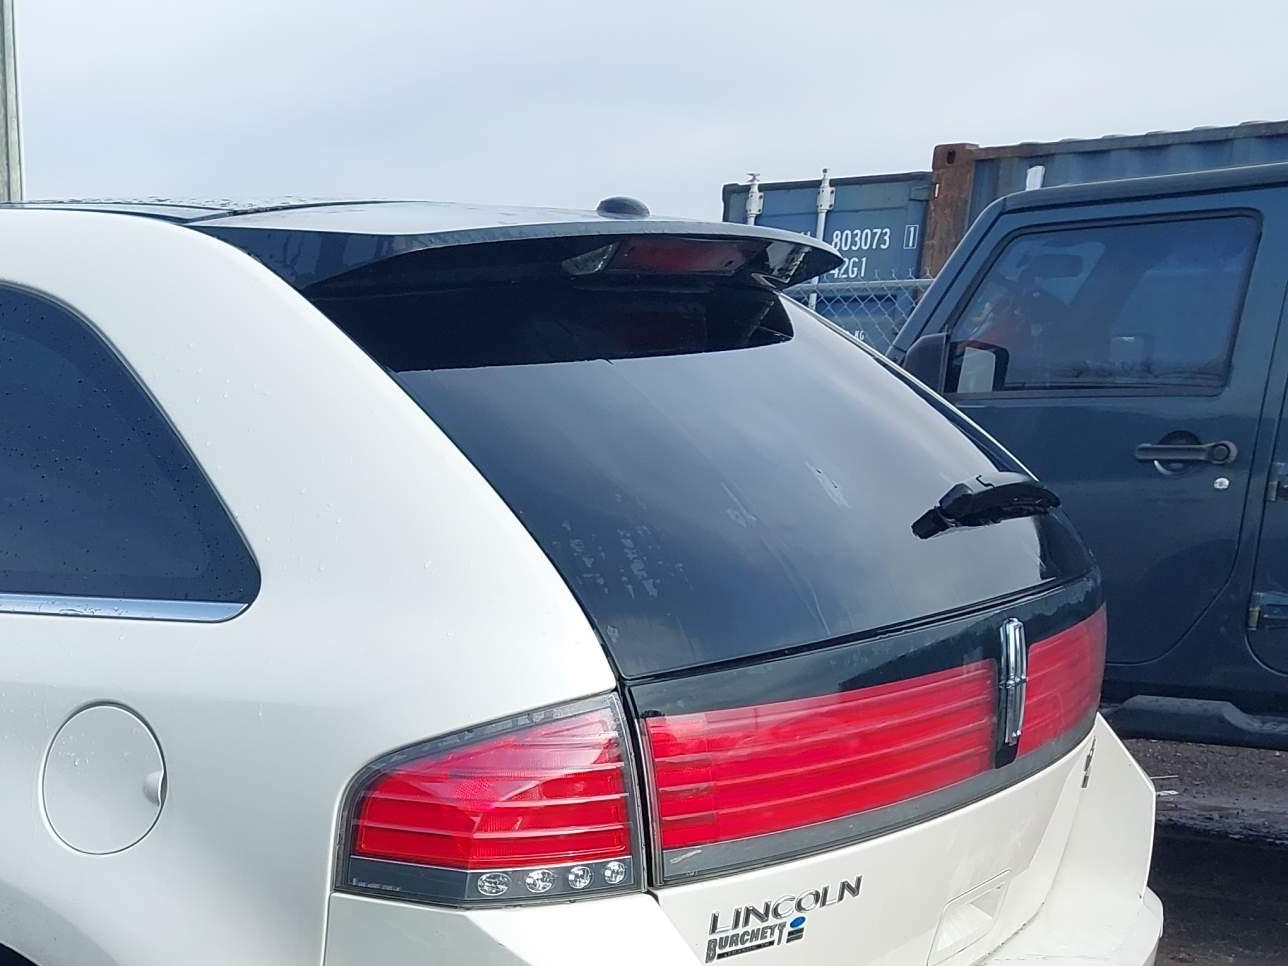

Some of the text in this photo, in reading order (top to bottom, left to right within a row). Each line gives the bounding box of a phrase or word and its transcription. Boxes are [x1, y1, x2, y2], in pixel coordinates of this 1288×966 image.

[832, 228, 891, 250] 803073
[709, 875, 863, 935] LINCOLN
[705, 921, 788, 964] BURCHETT
